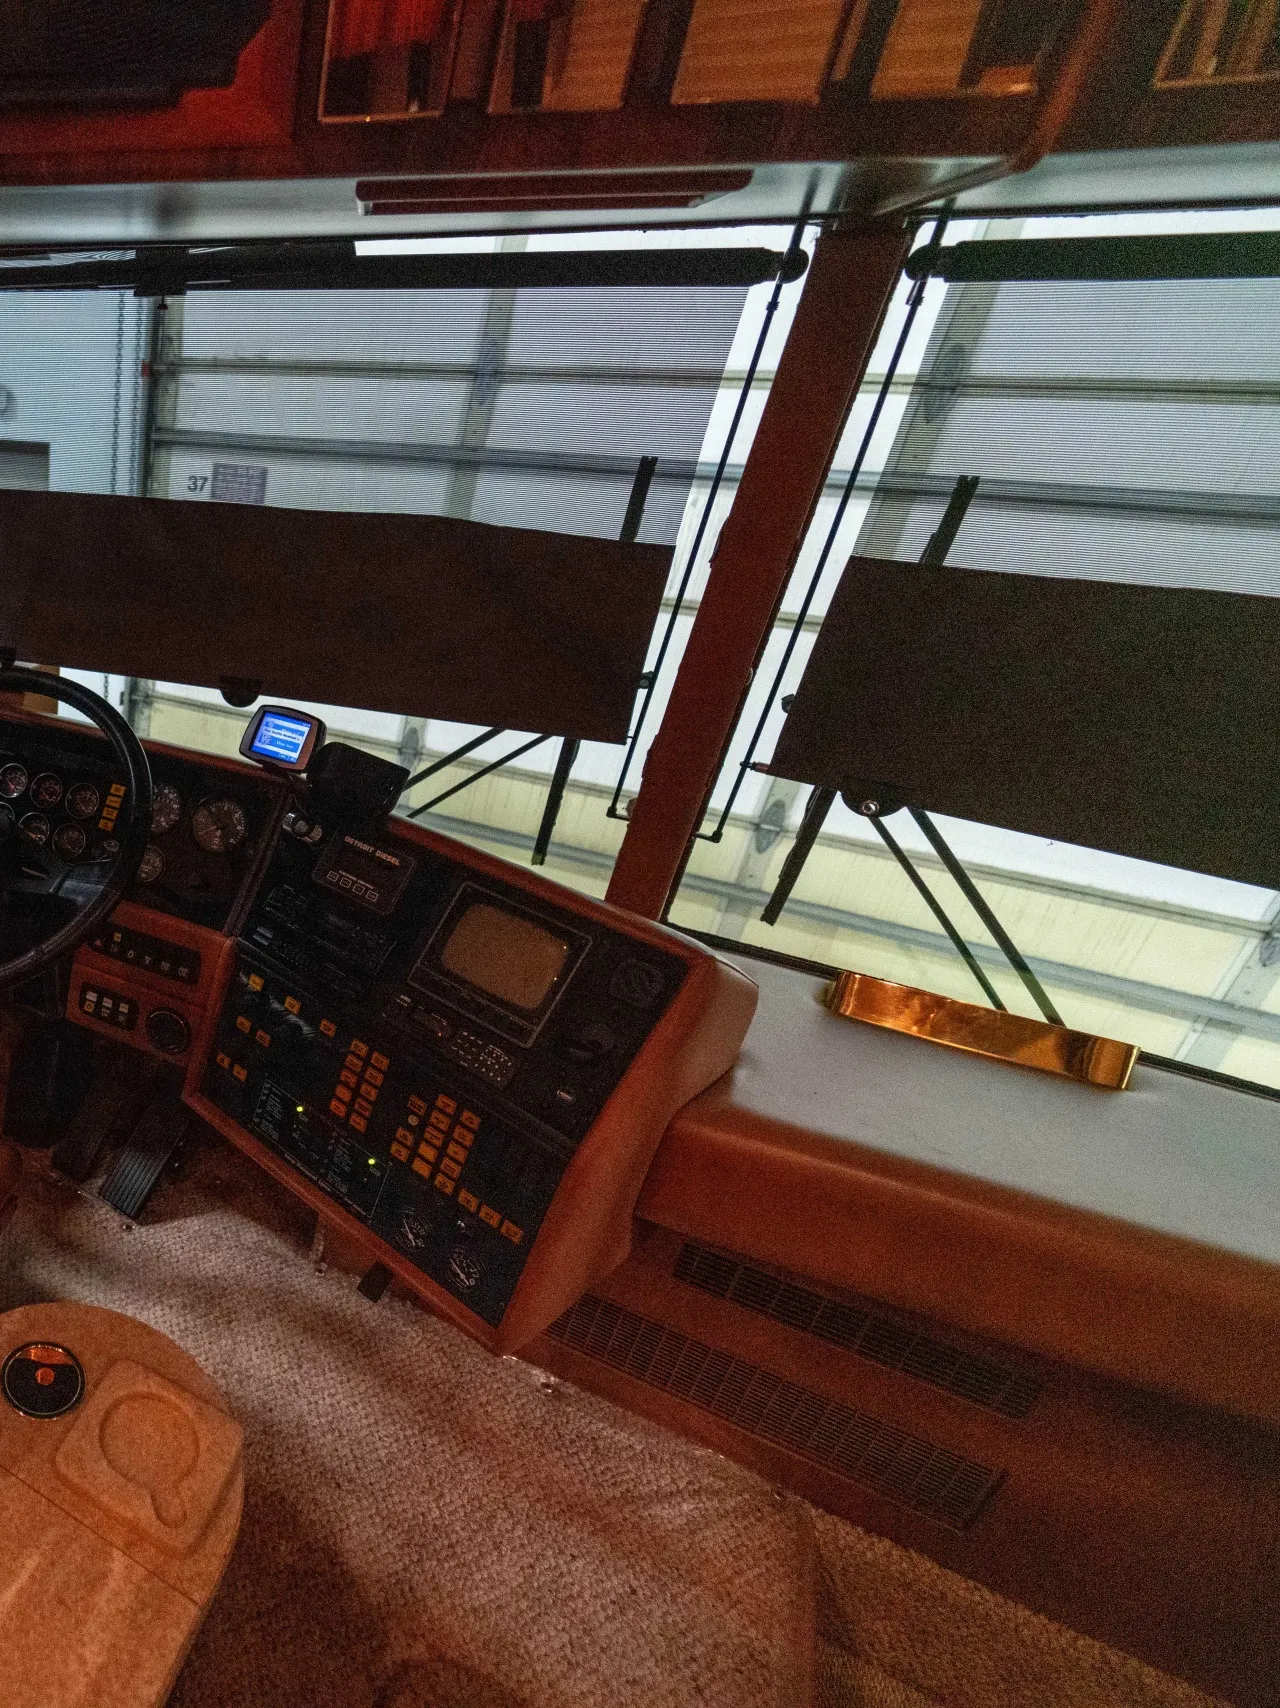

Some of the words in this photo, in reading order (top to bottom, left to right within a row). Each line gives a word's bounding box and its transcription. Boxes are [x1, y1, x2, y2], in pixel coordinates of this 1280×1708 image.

[187, 475, 208, 492] 37
[344, 835, 375, 853] DETROIT
[375, 849, 400, 866] DIESEL
